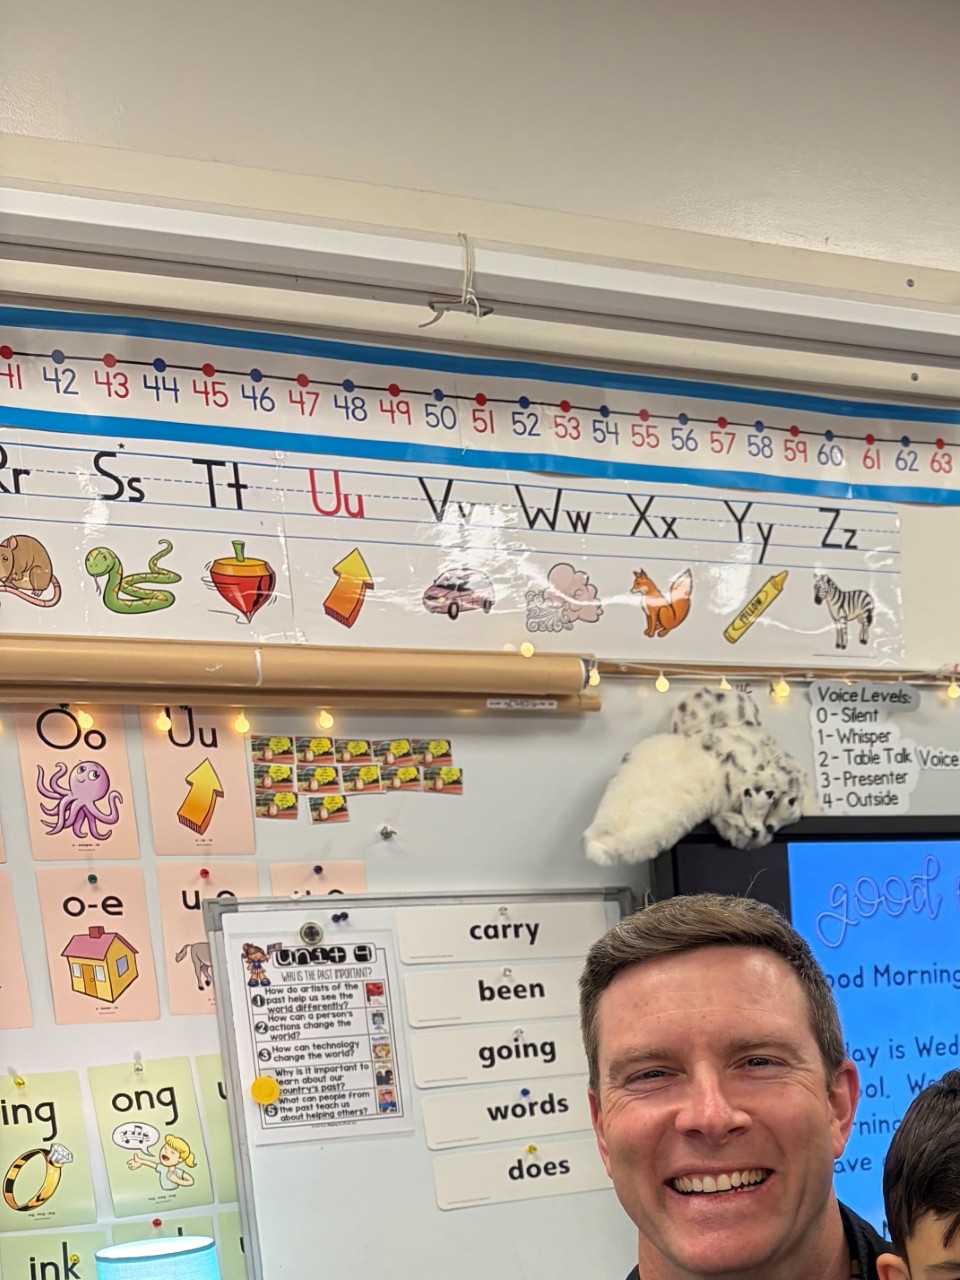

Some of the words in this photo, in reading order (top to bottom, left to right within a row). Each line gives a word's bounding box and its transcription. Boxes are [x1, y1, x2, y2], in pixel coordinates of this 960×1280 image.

[0, 363, 22, 390] 41
[43, 367, 79, 395] 42
[143, 375, 180, 403] 44
[193, 380, 229, 408] 45
[289, 389, 320, 416] 47
[335, 394, 368, 422] 48
[425, 403, 457, 430] 50
[512, 412, 541, 436] 52
[593, 419, 620, 445] 54
[671, 427, 698, 452] 56
[817, 442, 844, 466] 60
[895, 450, 919, 472] 62
[94, 451, 145, 503] Ss
[192, 458, 248, 510] Tt
[309, 468, 365, 518] Uu
[515, 484, 591, 533] Ww
[627, 493, 679, 538] Xx
[723, 500, 774, 564] Yy
[818, 508, 858, 550] Zz
[817, 686, 857, 702] Voice
[841, 708, 879, 723] Silent
[36, 708, 107, 750] Oo
[165, 706, 218, 749] Uu
[836, 729, 892, 748] Whisper
[845, 749, 885, 766] Table
[886, 748, 913, 765] Talk
[919, 751, 960, 767] Voice
[844, 771, 909, 788] Presenter
[846, 792, 899, 808] Outside
[62, 894, 124, 917] o-e
[815, 854, 943, 949] good
[469, 920, 540, 945] carry
[275, 947, 347, 967] unit
[353, 945, 373, 963] 4
[304, 969, 317, 980] THE
[317, 969, 333, 980] PAST
[334, 967, 373, 979] IMPORTANT?
[828, 964, 864, 990] ood
[265, 987, 284, 995] How
[287, 986, 298, 994] do
[300, 984, 330, 993] artists
[333, 982, 342, 991] of
[344, 982, 359, 991] the
[266, 996, 286, 1005] past
[288, 994, 306, 1005] help
[339, 992, 354, 1001] the
[479, 979, 546, 1002] been
[268, 1005, 293, 1014] world
[296, 1001, 350, 1013] differently?
[478, 1037, 557, 1069] going
[889, 1038, 906, 1060] is
[1, 1099, 59, 1142] ing
[112, 1086, 180, 1126] ong
[280, 1113, 304, 1122] about
[306, 1110, 335, 1121] helping
[337, 1107, 369, 1117] others?
[487, 1092, 569, 1122] words
[508, 1158, 571, 1181] does
[834, 1157, 872, 1175] ave
